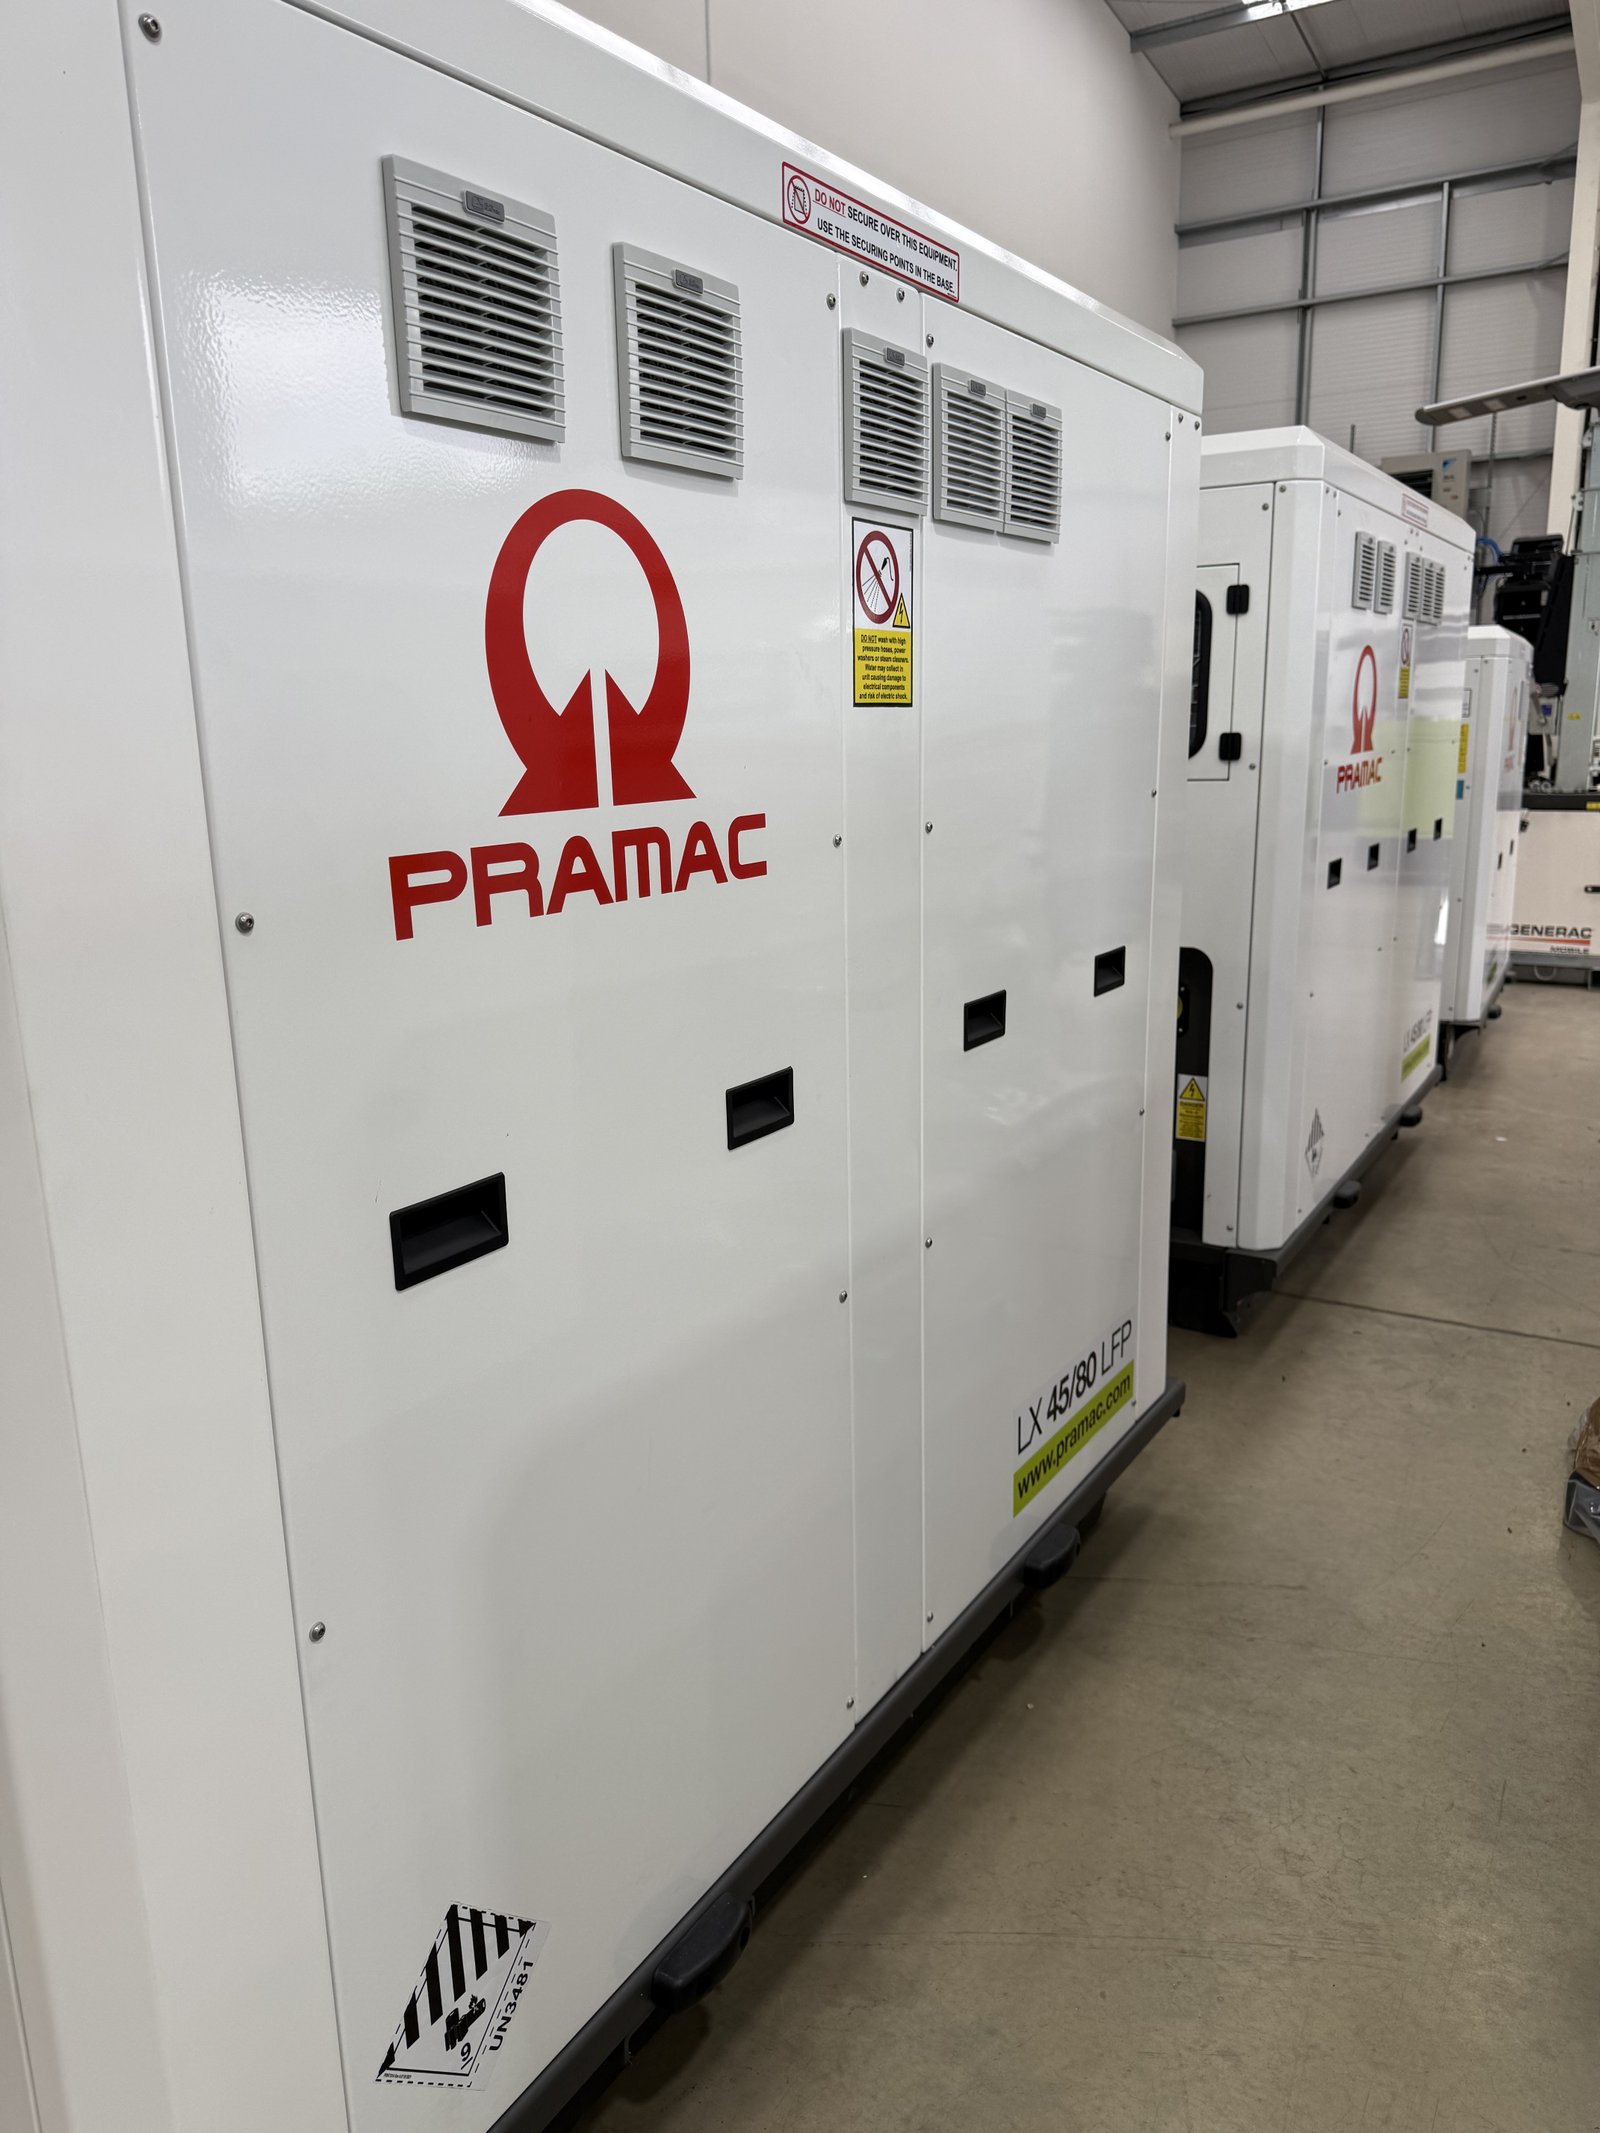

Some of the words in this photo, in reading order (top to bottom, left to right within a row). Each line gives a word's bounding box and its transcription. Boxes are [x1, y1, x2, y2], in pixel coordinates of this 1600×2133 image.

[815, 188, 827, 205] DO
[829, 195, 846, 215] NOT
[847, 206, 879, 232] SECURE
[880, 222, 901, 243] OVER
[902, 233, 918, 251] THIS
[919, 242, 957, 272] EQUIPMENT.
[817, 217, 833, 236] USE
[835, 226, 850, 244] THE
[851, 234, 888, 262] SECURING
[889, 253, 914, 274] POINTS
[915, 264, 922, 278] IN
[923, 268, 936, 284] THE
[936, 275, 955, 294] BASE.
[861, 634, 867, 643] DO
[868, 635, 877, 643] NOT
[898, 637, 906, 646] high
[870, 674, 886, 682] causing
[887, 675, 902, 683] damage
[881, 646, 893, 654] hoses,
[388, 813, 767, 941] PRAMAC
[1018, 1397, 1042, 1455] LX
[1047, 1351, 1096, 1422] 45/80
[1102, 1320, 1132, 1376] LFP
[1017, 1375, 1130, 1499] www.pramac.com
[489, 1960, 533, 2051] UN3481
[460, 2042, 472, 2062] 9
